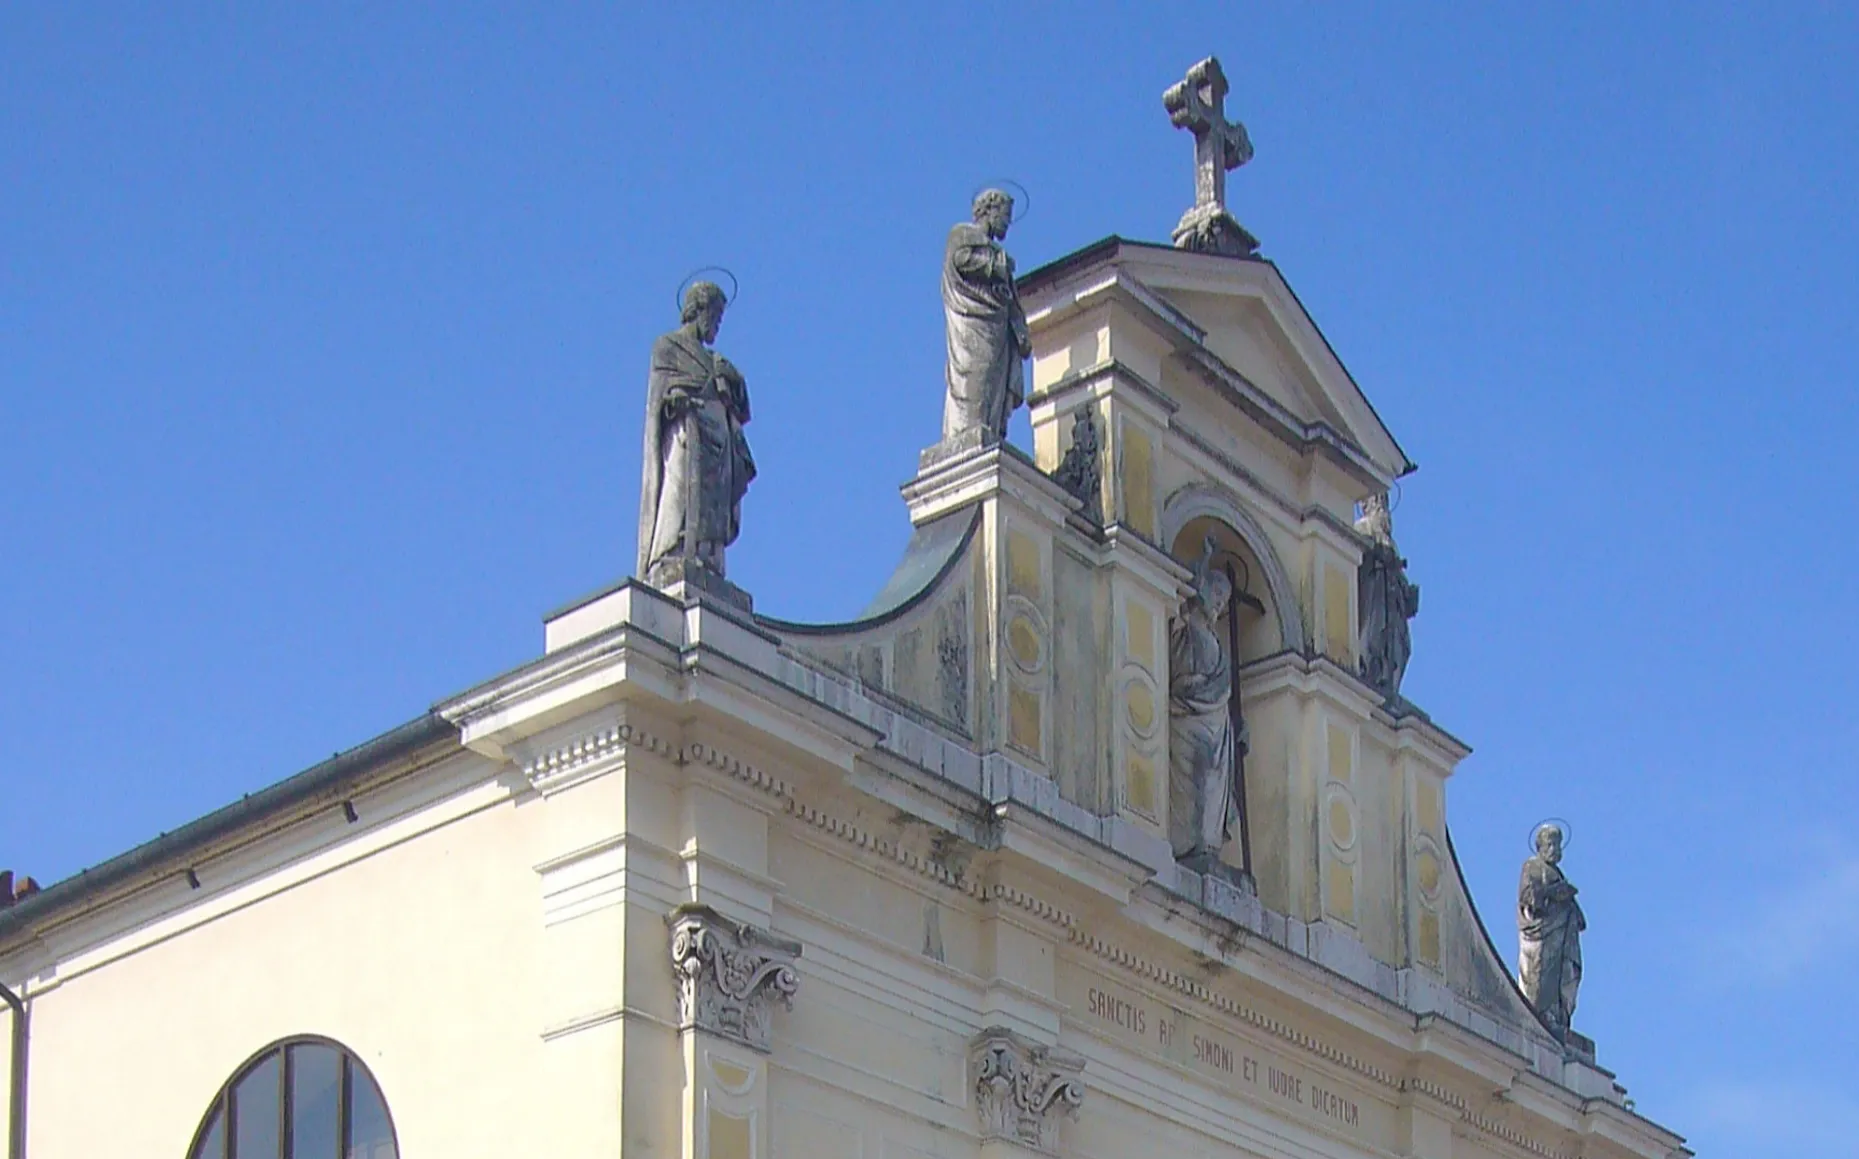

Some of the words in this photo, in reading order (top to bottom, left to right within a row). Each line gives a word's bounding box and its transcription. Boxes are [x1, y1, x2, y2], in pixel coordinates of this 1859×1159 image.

[1088, 987, 1146, 1034] SANCTIS
[1193, 1034, 1234, 1074] SIMONI
[1243, 1056, 1259, 1084] ET
[1311, 1085, 1359, 1128] DICATUM
